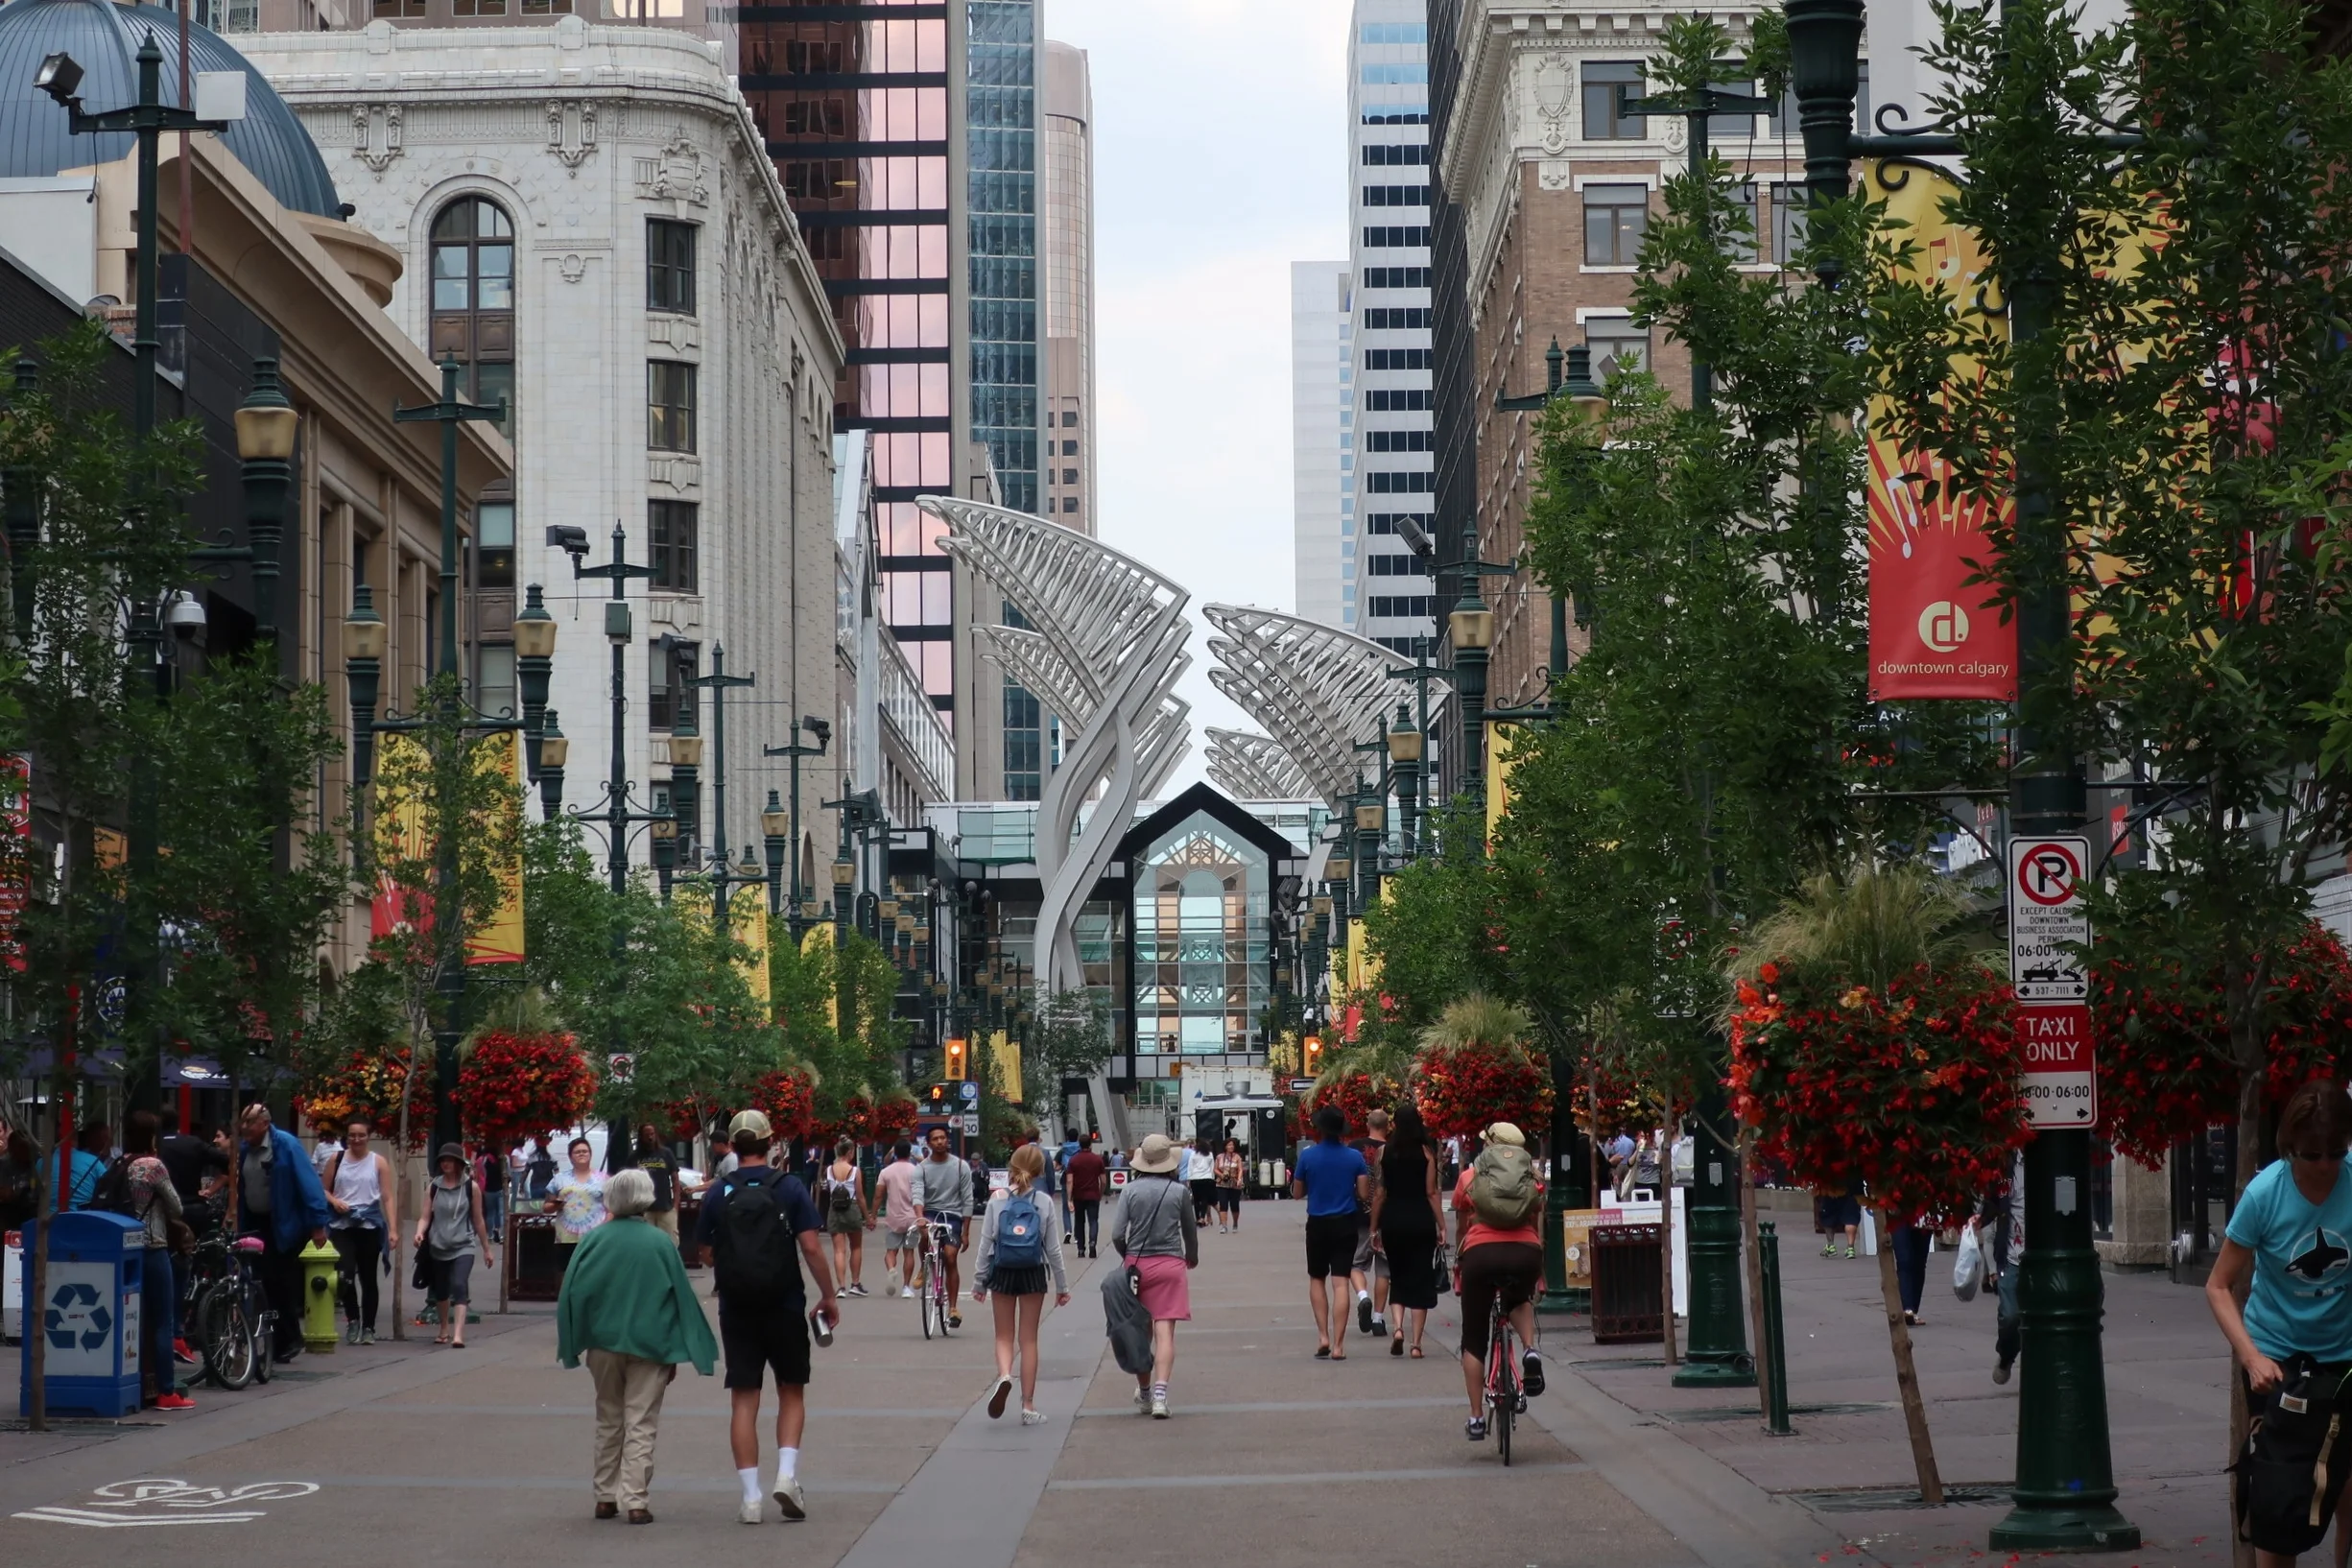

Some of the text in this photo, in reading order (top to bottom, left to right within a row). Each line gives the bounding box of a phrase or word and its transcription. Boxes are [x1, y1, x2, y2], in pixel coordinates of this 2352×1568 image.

[1878, 660, 2009, 677] downtown calgary
[2020, 907, 2080, 915] EXCEPT CALG
[2048, 925, 2085, 934] ASSOCIATION
[2026, 1017, 2075, 1036] TAXI
[2027, 1041, 2079, 1061] ONLY
[964, 1124, 978, 1133] 30
